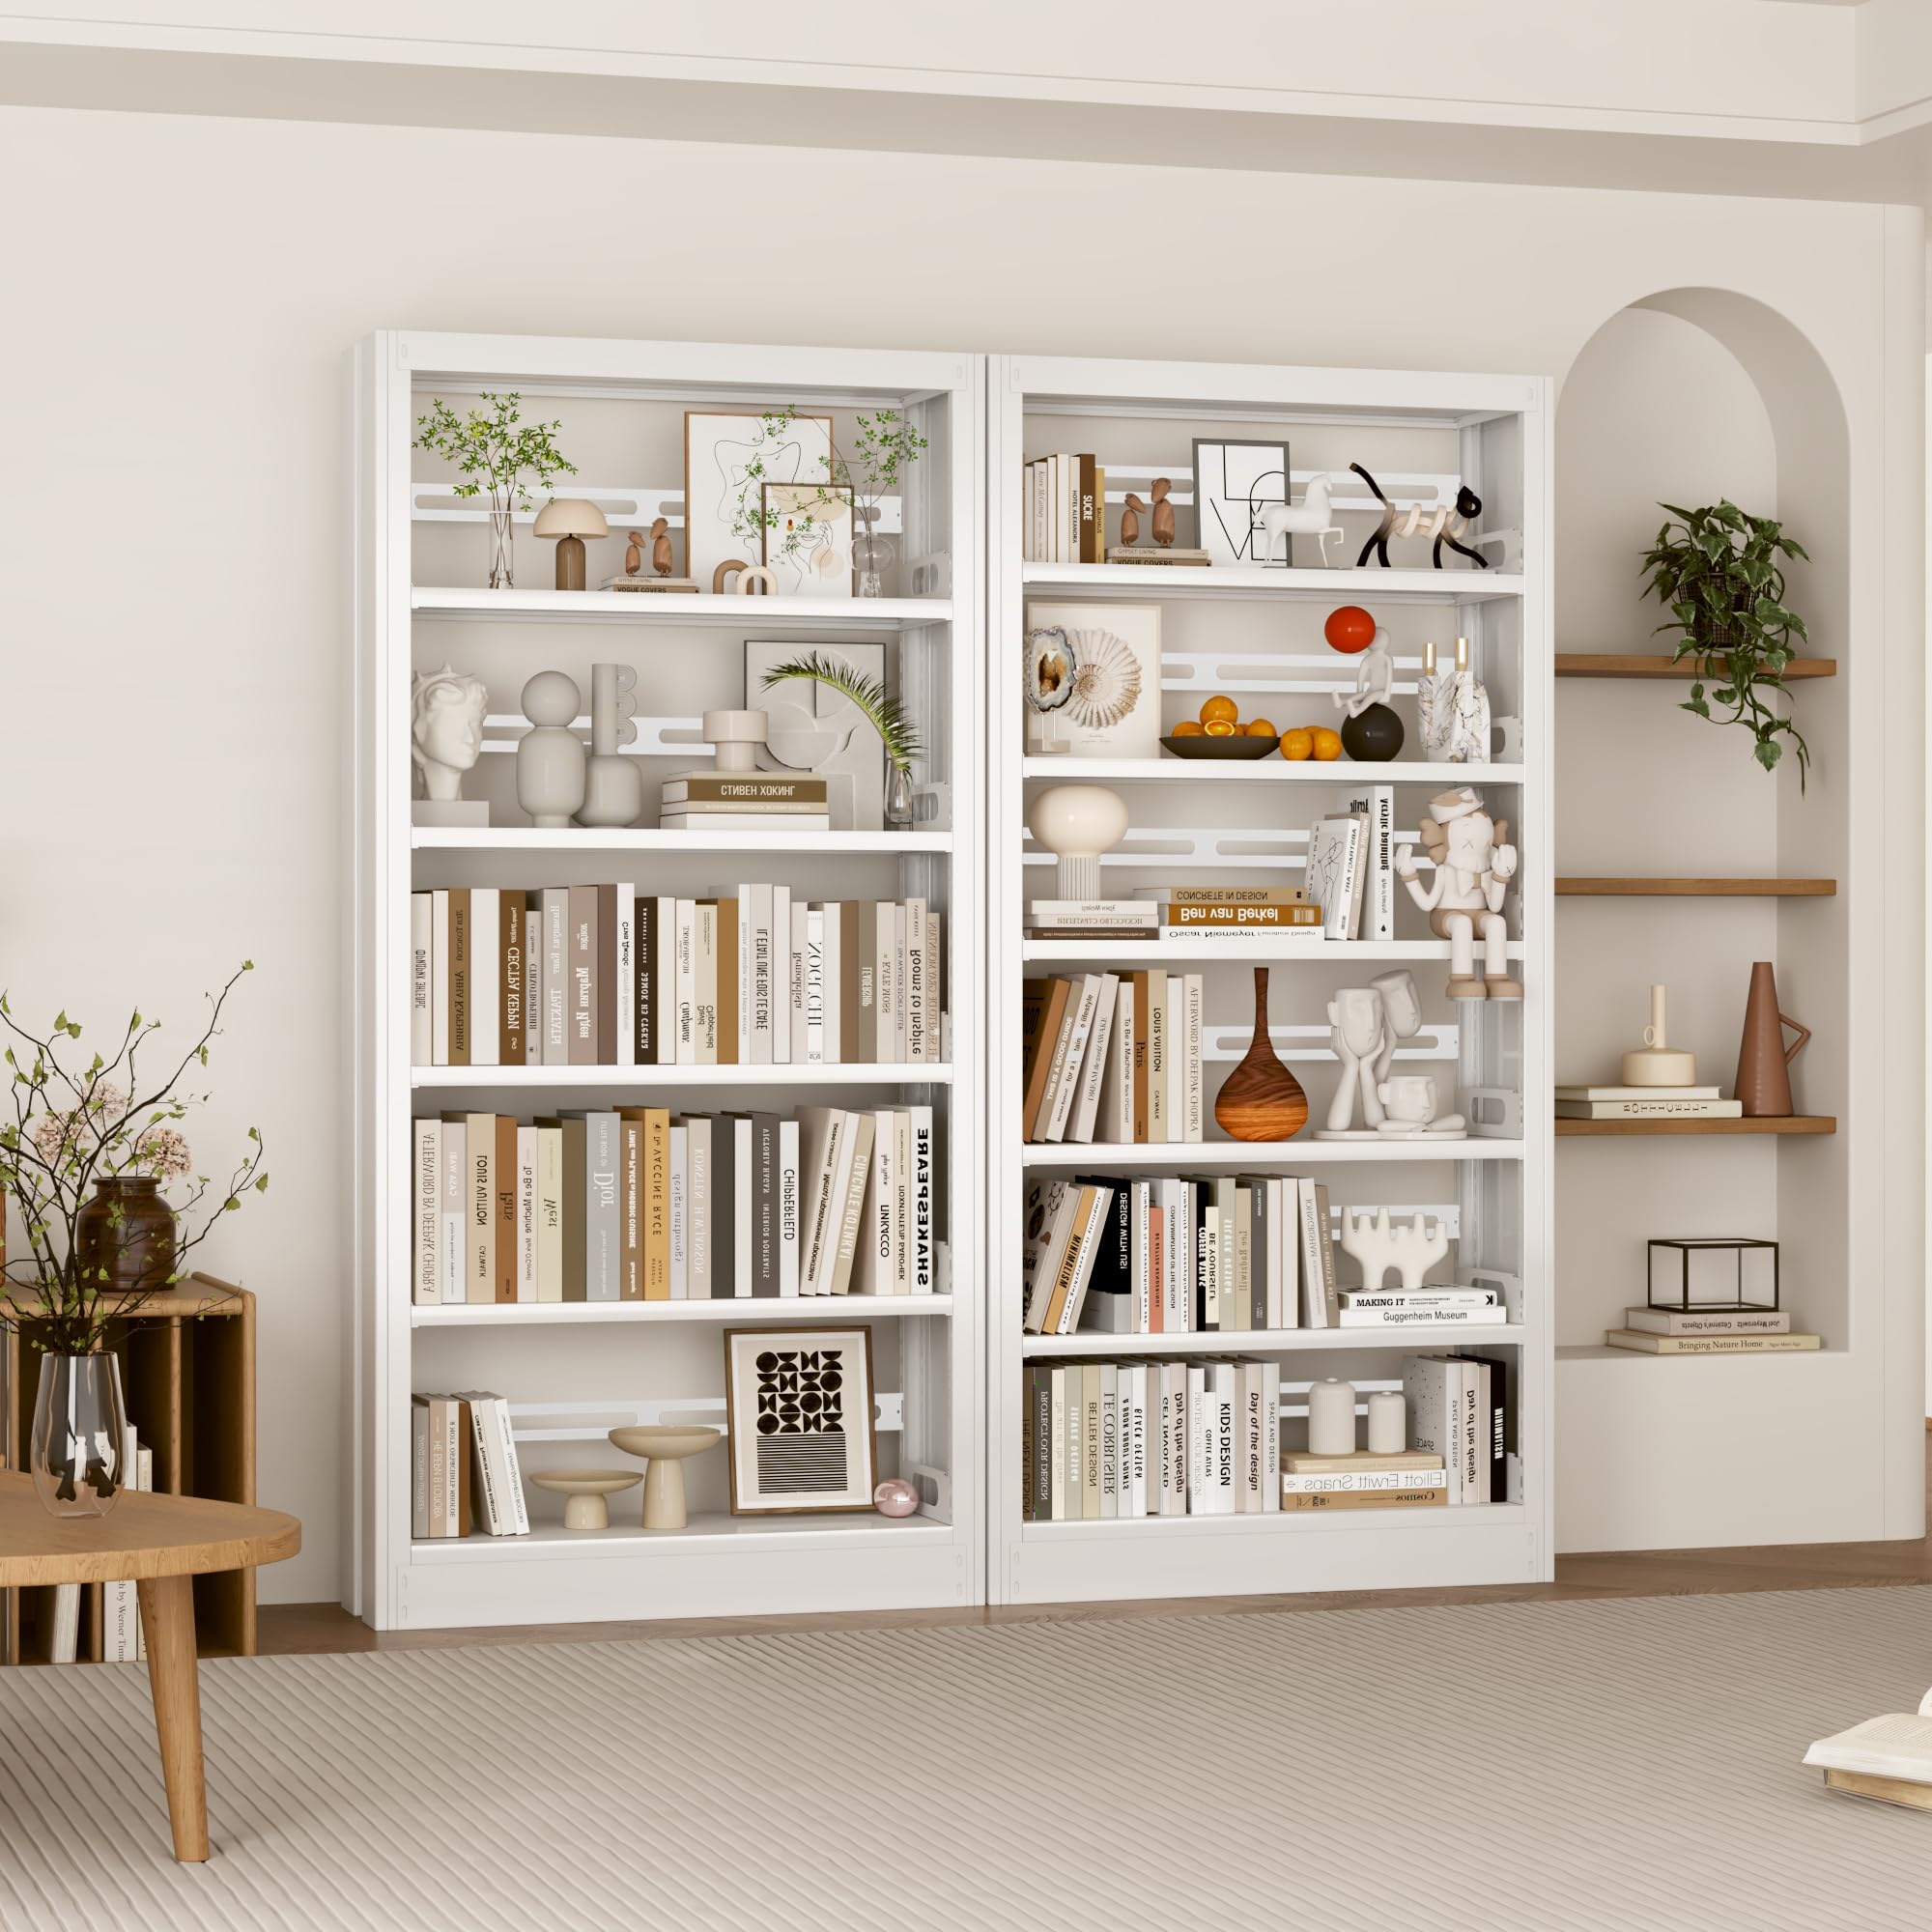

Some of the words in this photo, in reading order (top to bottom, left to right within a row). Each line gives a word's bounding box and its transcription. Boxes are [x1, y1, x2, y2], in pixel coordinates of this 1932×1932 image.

[1083, 495, 1094, 522] SUCRE
[721, 784, 757, 796] СТИВЕН
[759, 785, 796, 797] ХОКИНГ
[1153, 1008, 1162, 1034] LOUIS
[1190, 986, 1199, 1043] AFTERWORD
[1153, 1035, 1162, 1072] VUITTON
[1190, 1045, 1199, 1056] BY
[1190, 1059, 1199, 1093] DEEPAK
[1190, 1094, 1199, 1131] CHOPRA
[1623, 1103, 1708, 1114] BOTTICELLI
[1059, 1234, 1082, 1289] MINIMALISM
[1383, 1312, 1433, 1323] Guggenheim
[1434, 1311, 1467, 1320] Museum
[1682, 1321, 1703, 1330] Objects
[1737, 1320, 1768, 1328] Meyerowitz
[1678, 1341, 1711, 1350] Bringing
[1712, 1340, 1740, 1349] Nature
[1249, 1392, 1260, 1413] Day
[1220, 1403, 1231, 1434] KIDS
[1250, 1417, 1259, 1430] of
[1250, 1432, 1259, 1450] the
[1220, 1436, 1231, 1487] DESIGN
[1249, 1453, 1260, 1492] design
[117, 1591, 127, 1603] by
